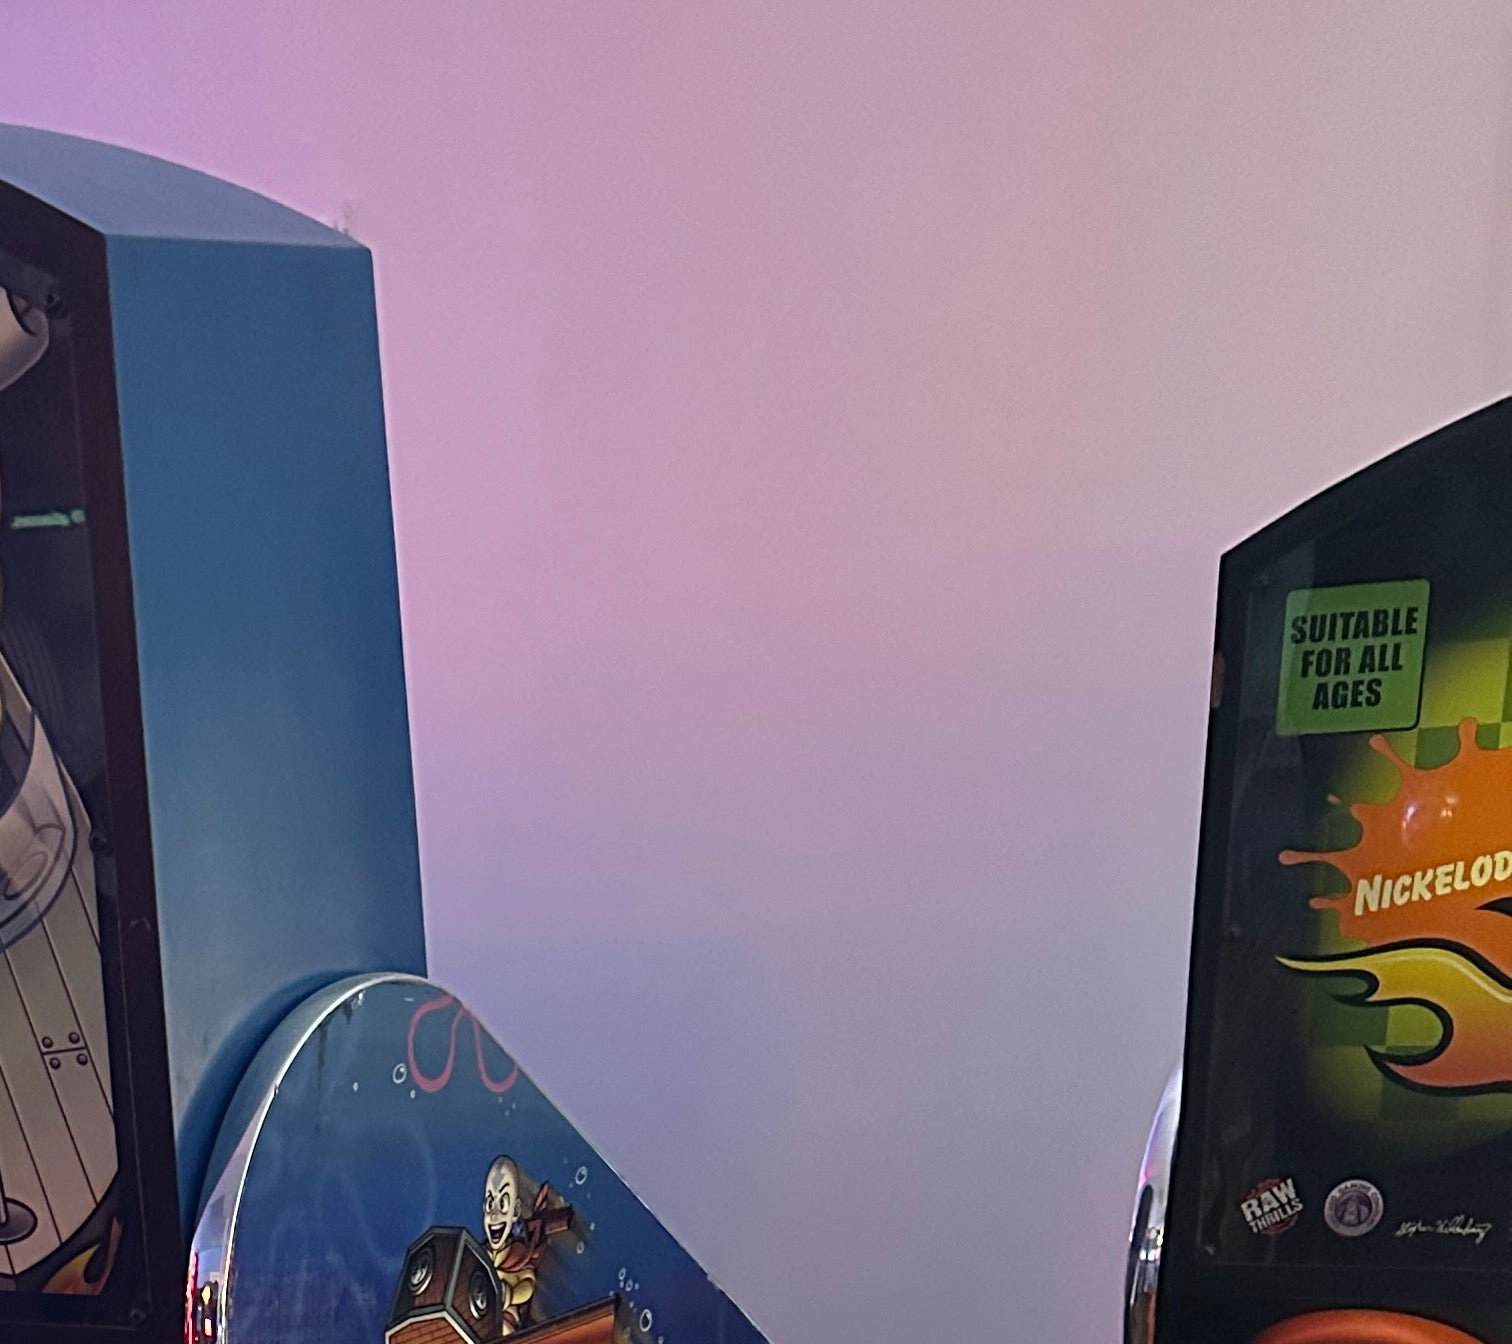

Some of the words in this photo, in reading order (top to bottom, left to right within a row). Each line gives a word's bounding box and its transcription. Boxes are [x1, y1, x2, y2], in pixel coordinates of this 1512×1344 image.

[1290, 606, 1419, 645] SUITABLE
[1300, 648, 1351, 678] FOR
[1358, 642, 1403, 674] ALL
[1312, 678, 1383, 710] AGES
[1241, 1178, 1296, 1222] RAW
[1249, 1199, 1304, 1234] THRILLS
